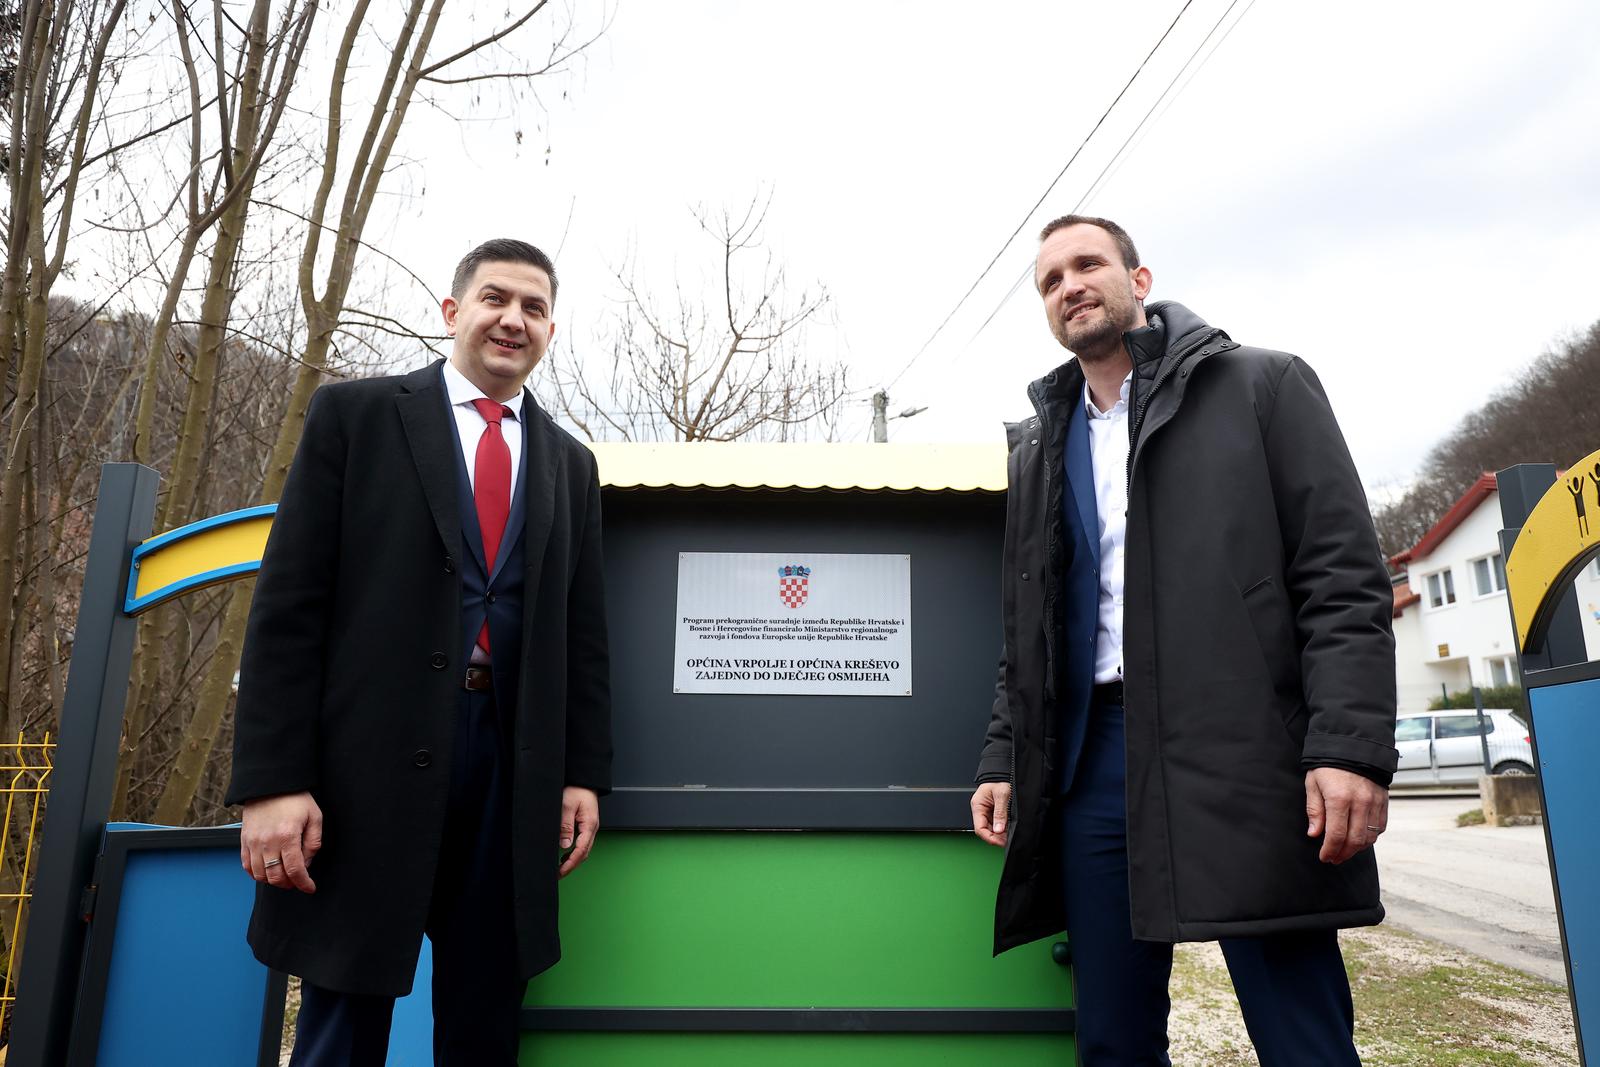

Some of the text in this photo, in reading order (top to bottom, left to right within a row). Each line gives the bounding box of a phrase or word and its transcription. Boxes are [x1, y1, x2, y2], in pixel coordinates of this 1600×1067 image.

[683, 617, 714, 625] Program
[716, 617, 767, 625] prekogranične
[769, 618, 800, 626] suradnje
[830, 618, 866, 626] Republike
[686, 657, 900, 669] OPĆINA VRPOLJE I OPĆINA KREŠEVO
[696, 670, 890, 681] ZAJEDNO DO DJEČJEG OSMIJEHA
